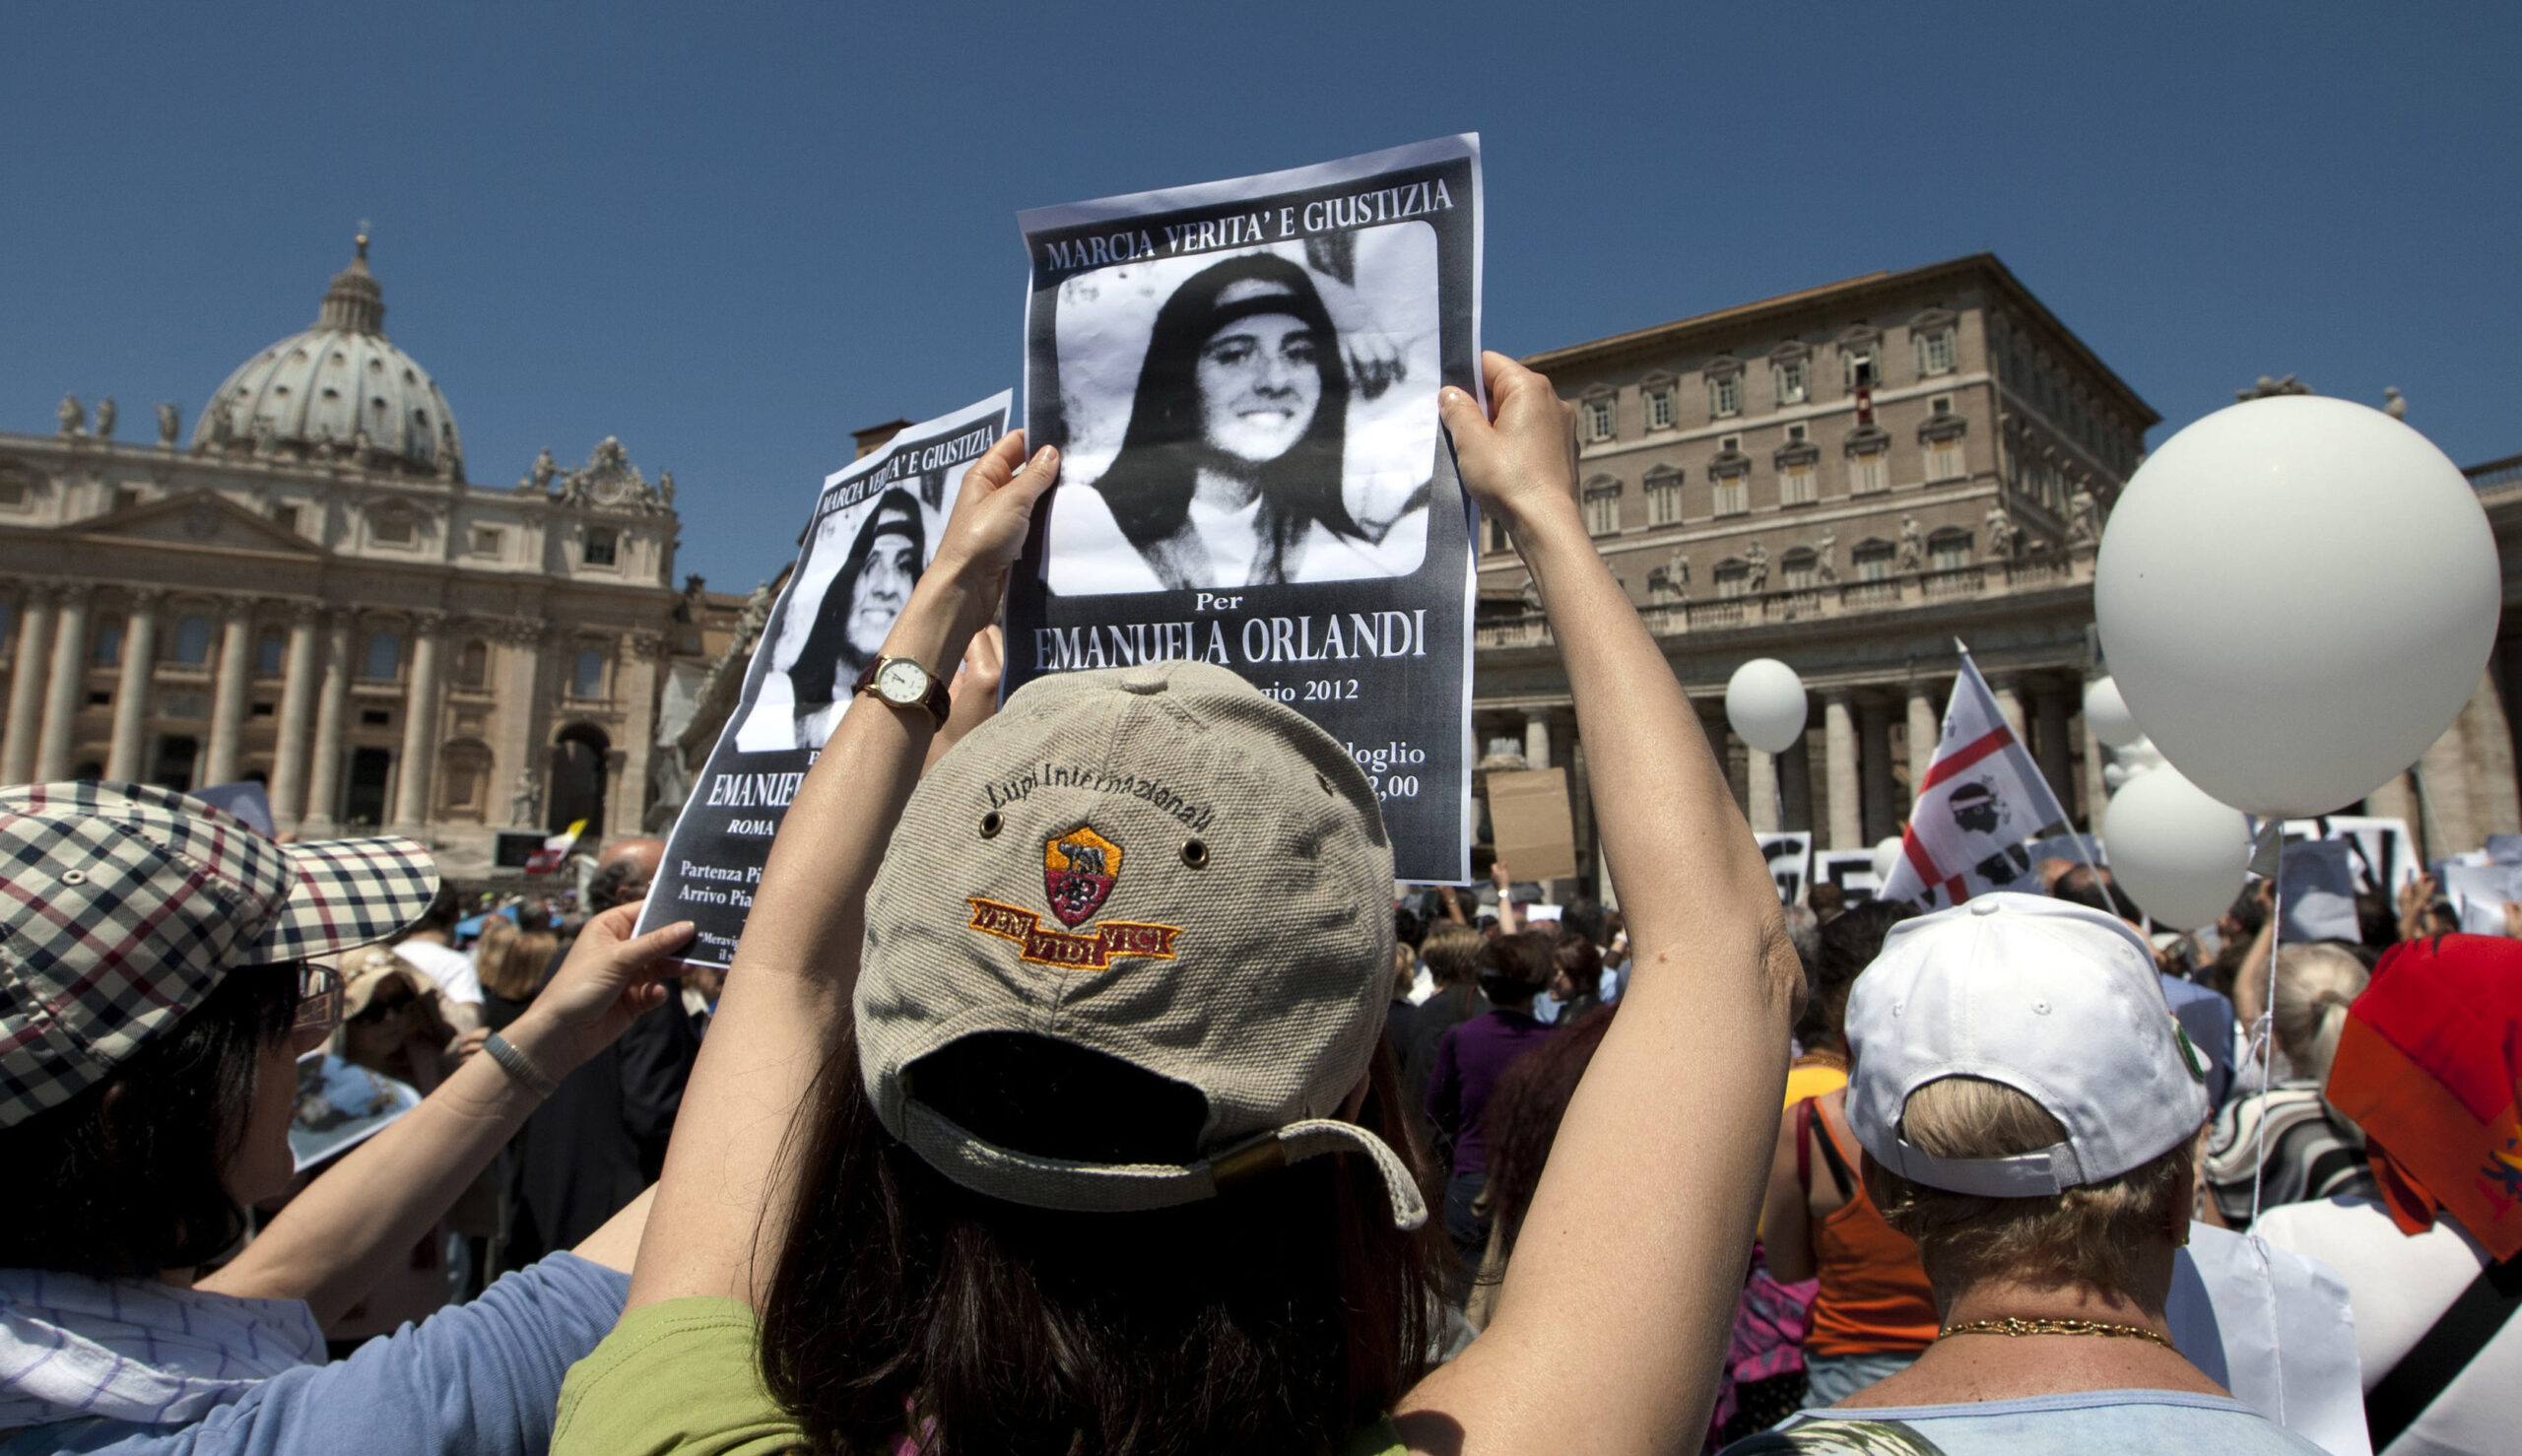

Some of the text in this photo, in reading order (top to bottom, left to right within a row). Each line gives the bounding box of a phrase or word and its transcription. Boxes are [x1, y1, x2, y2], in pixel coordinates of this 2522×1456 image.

[1045, 177, 1455, 272] MARCIA VERITA' E GIUSTIZIA
[819, 479, 865, 516] MARCIA
[907, 449, 920, 476] E
[922, 424, 994, 472] GIUSTIZIA
[1194, 591, 1243, 612] Per
[1033, 608, 1428, 671] EMANUELA ORLANDI
[1303, 679, 1360, 701] 2012
[726, 819, 775, 836] ROMA
[680, 859, 743, 883] Partenza
[678, 884, 727, 904] Arrivo
[979, 906, 1161, 964] VENI VIDI VICI
